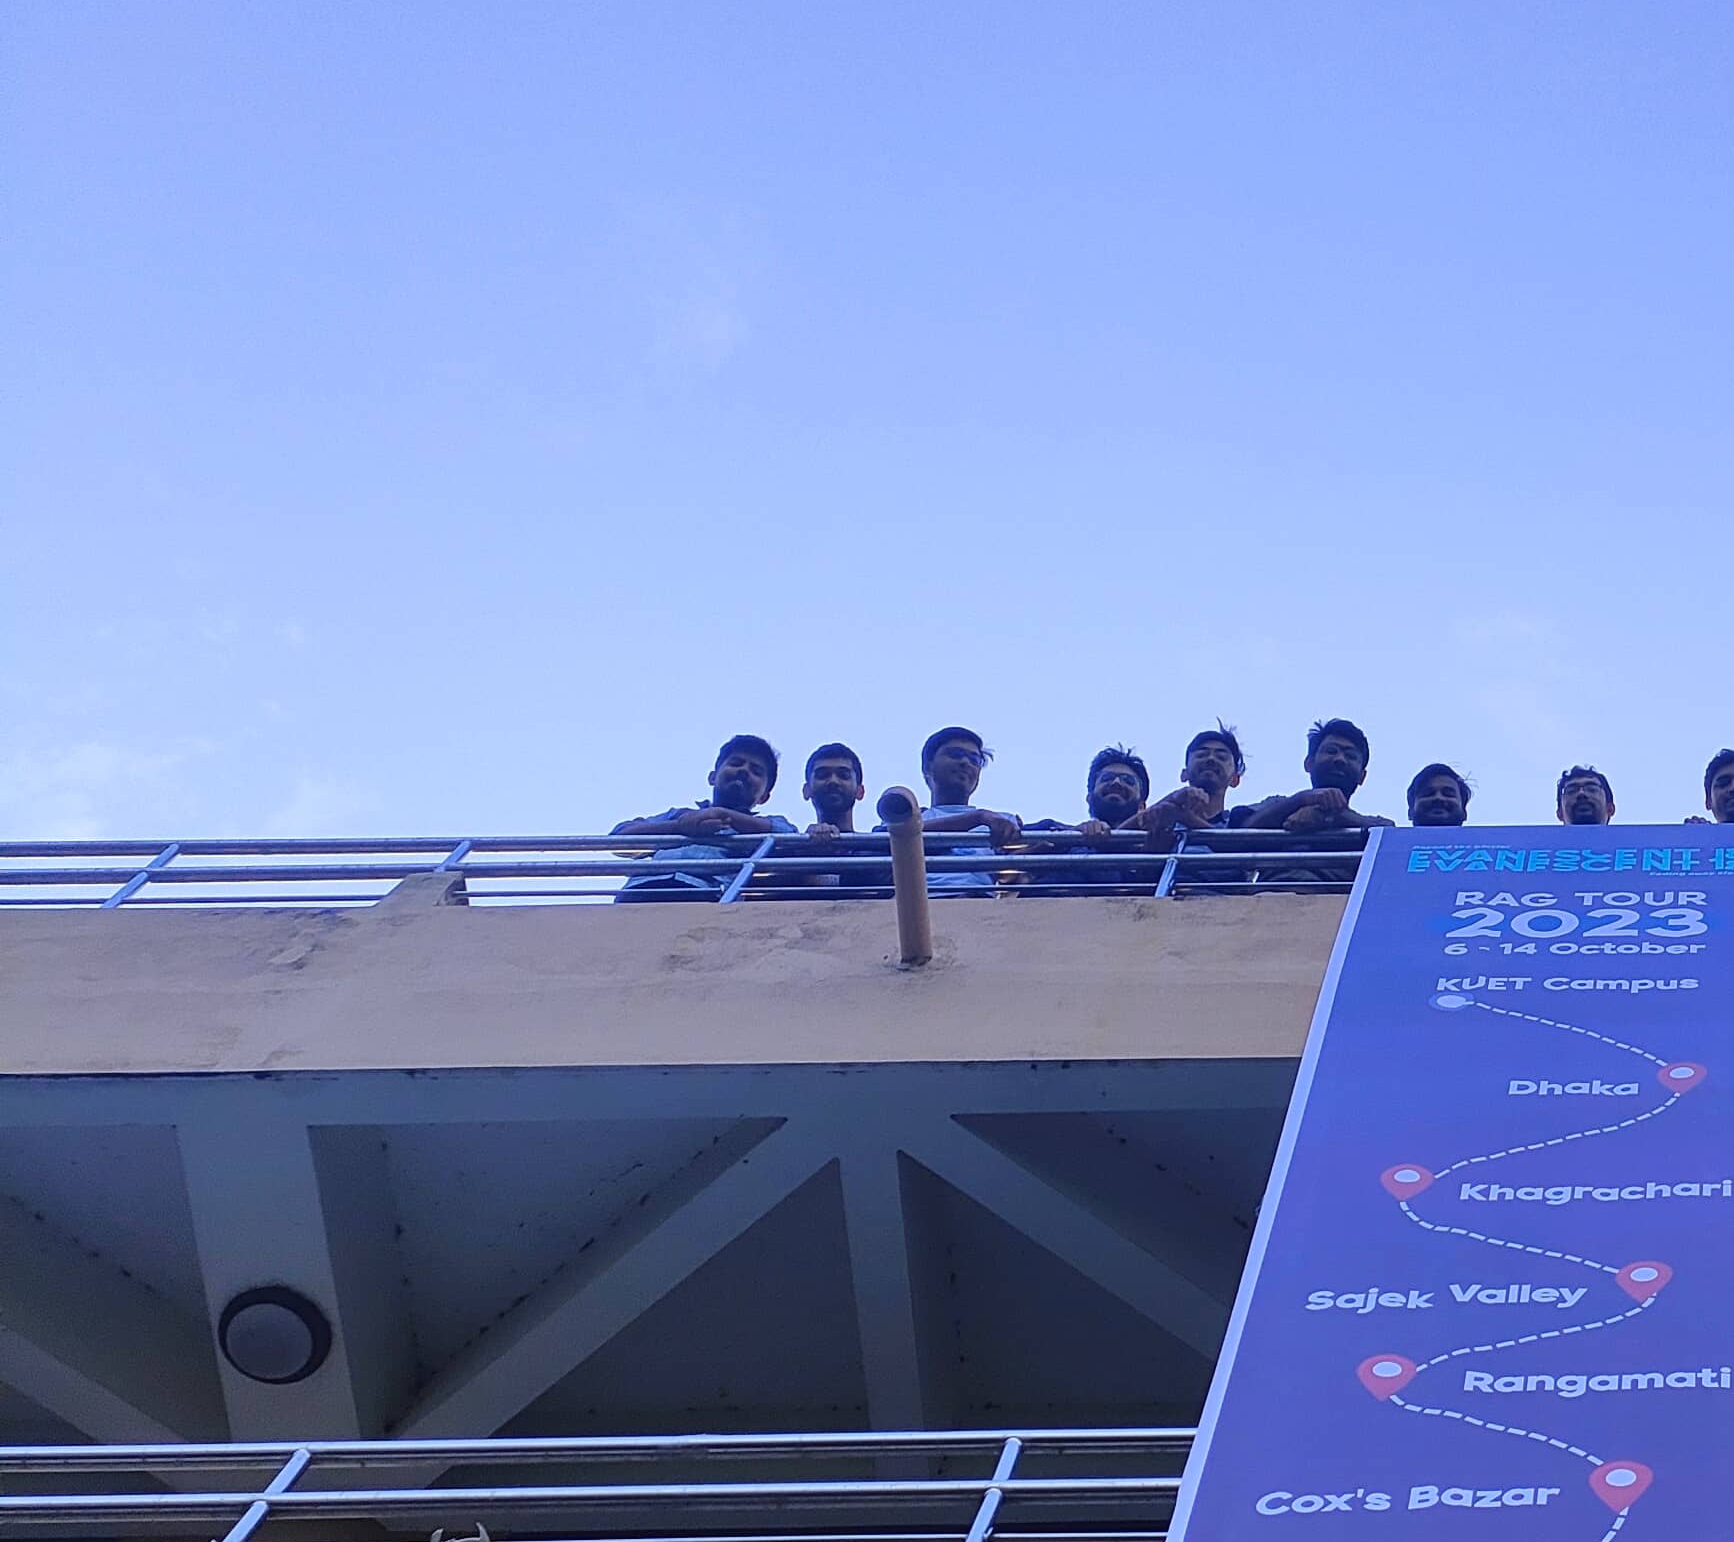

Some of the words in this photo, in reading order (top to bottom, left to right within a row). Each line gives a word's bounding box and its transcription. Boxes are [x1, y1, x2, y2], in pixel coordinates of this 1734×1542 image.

[1455, 891, 1558, 907] RAG
[1574, 891, 1708, 907] TOUR
[1445, 908, 1709, 939] 2023
[1444, 942, 1468, 956] 6
[1499, 942, 1538, 956] 14
[1549, 941, 1707, 956] October
[1436, 975, 1533, 992] KUET
[1543, 977, 1700, 995] Campus
[1508, 1079, 1640, 1096] Dhaka
[1459, 1179, 1733, 1206] Khagrachari
[1304, 1287, 1435, 1314] Sajek
[1449, 1283, 1588, 1309] Valley
[1463, 1366, 1732, 1398] Rangamati
[1255, 1488, 1392, 1516] Cox's
[1407, 1483, 1561, 1511] Bazar
